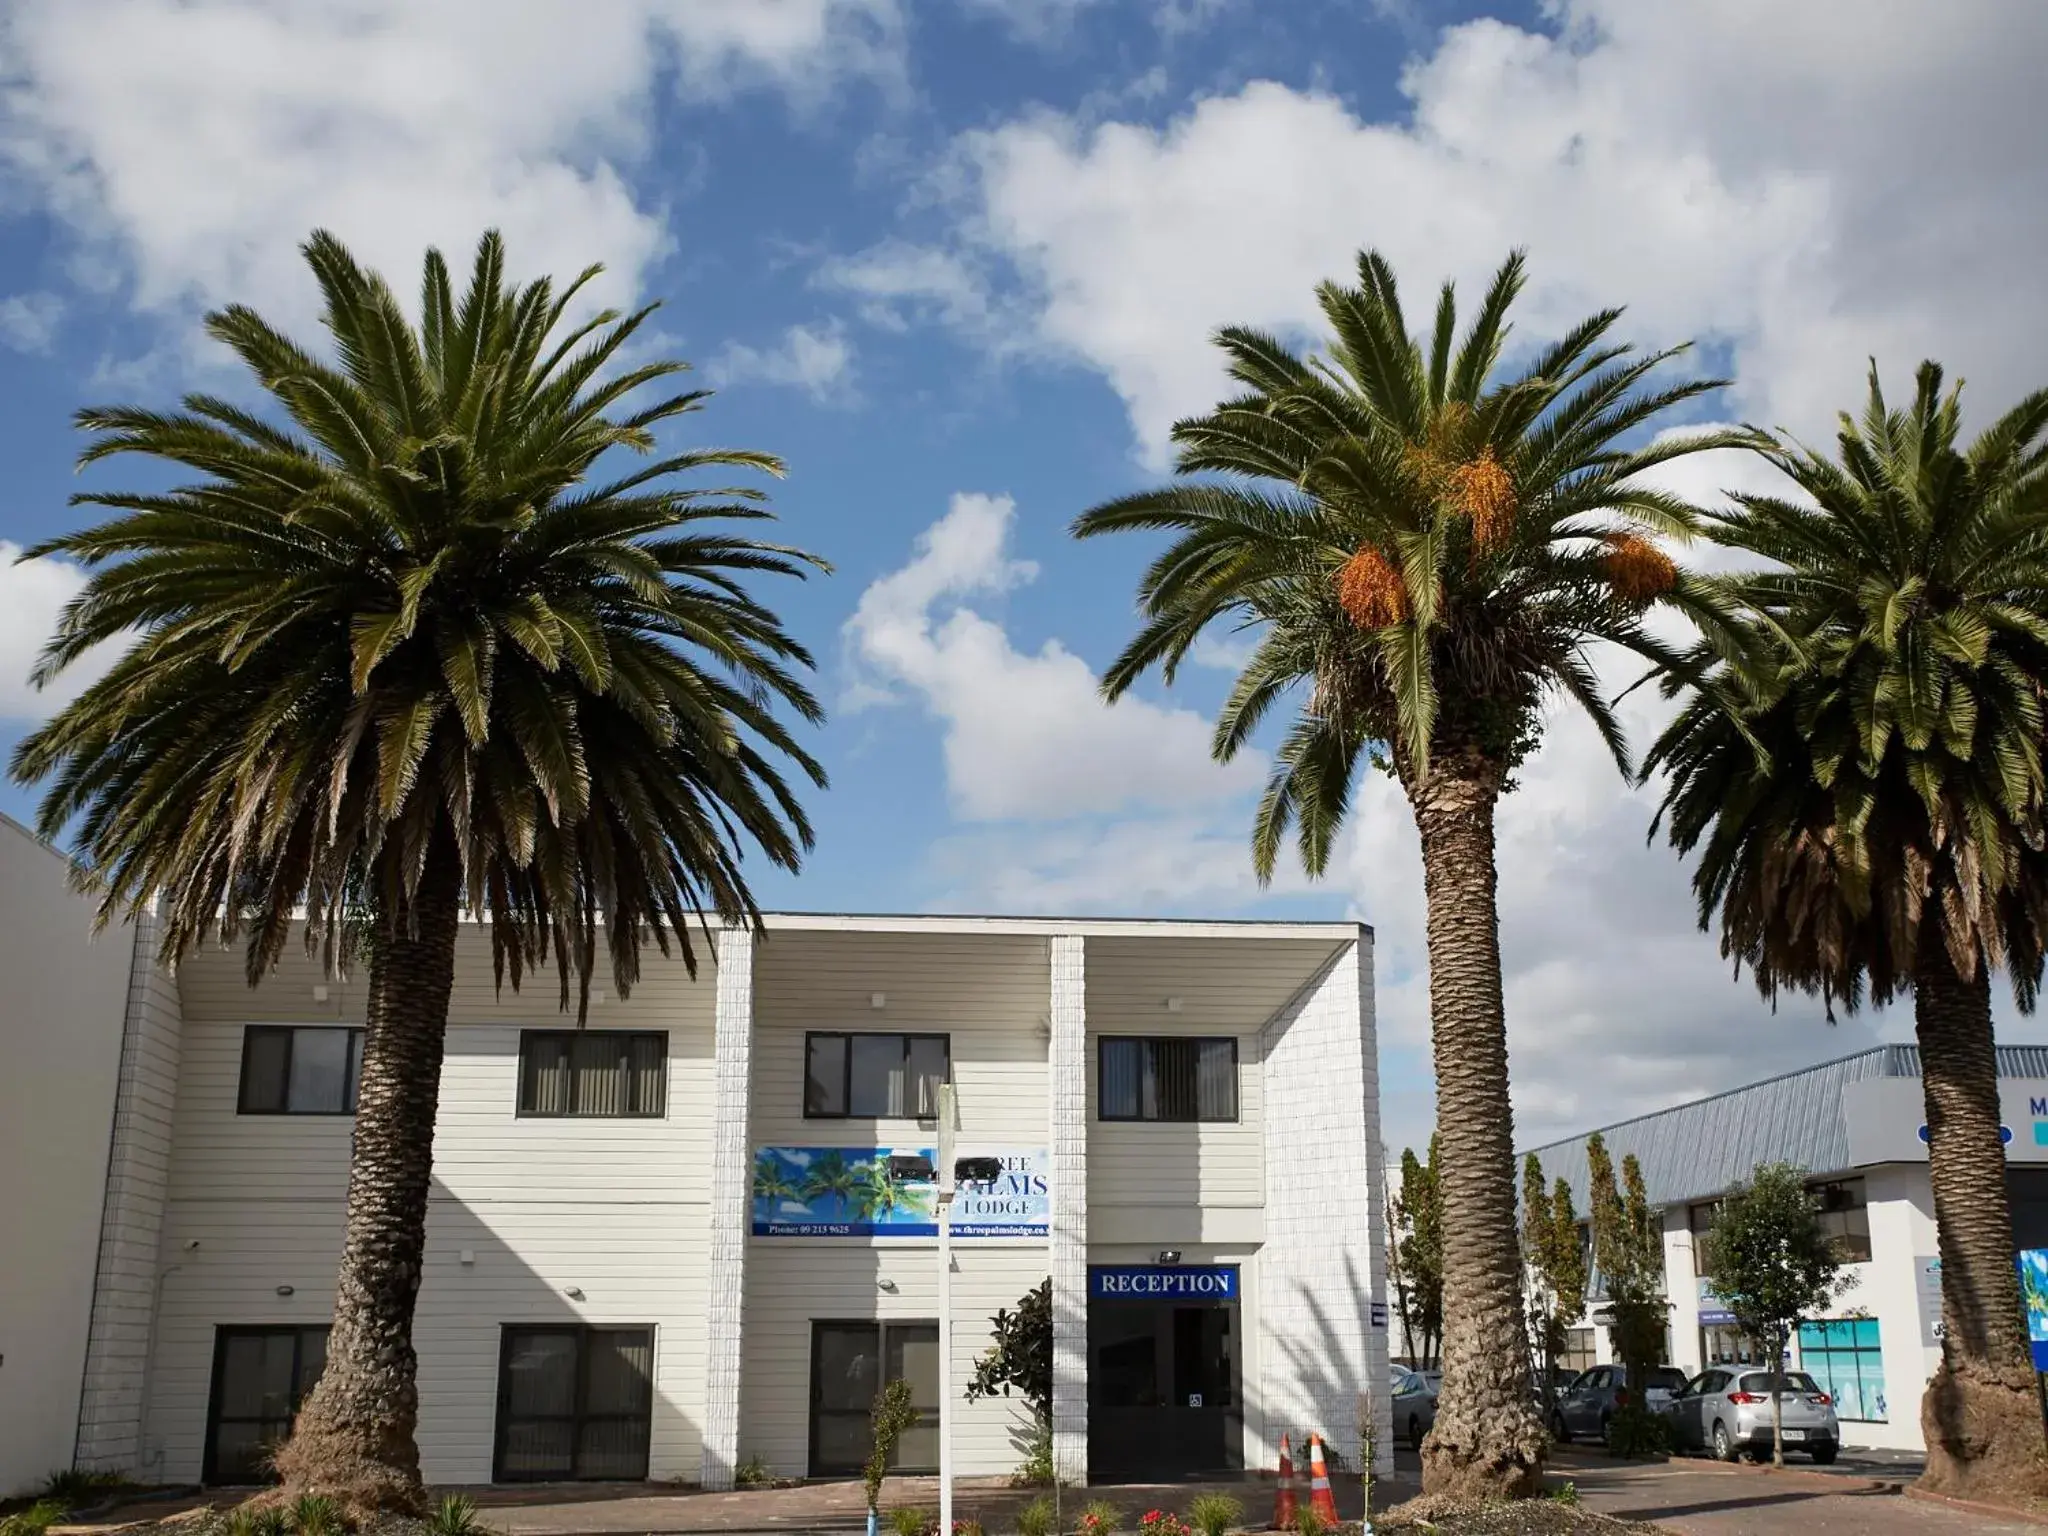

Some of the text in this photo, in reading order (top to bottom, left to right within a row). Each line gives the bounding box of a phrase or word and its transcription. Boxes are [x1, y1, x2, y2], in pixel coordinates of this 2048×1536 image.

[964, 1200, 1033, 1215] LODGE
[768, 1225, 798, 1234] Phone:
[1101, 1274, 1230, 1293] RECEPTION
